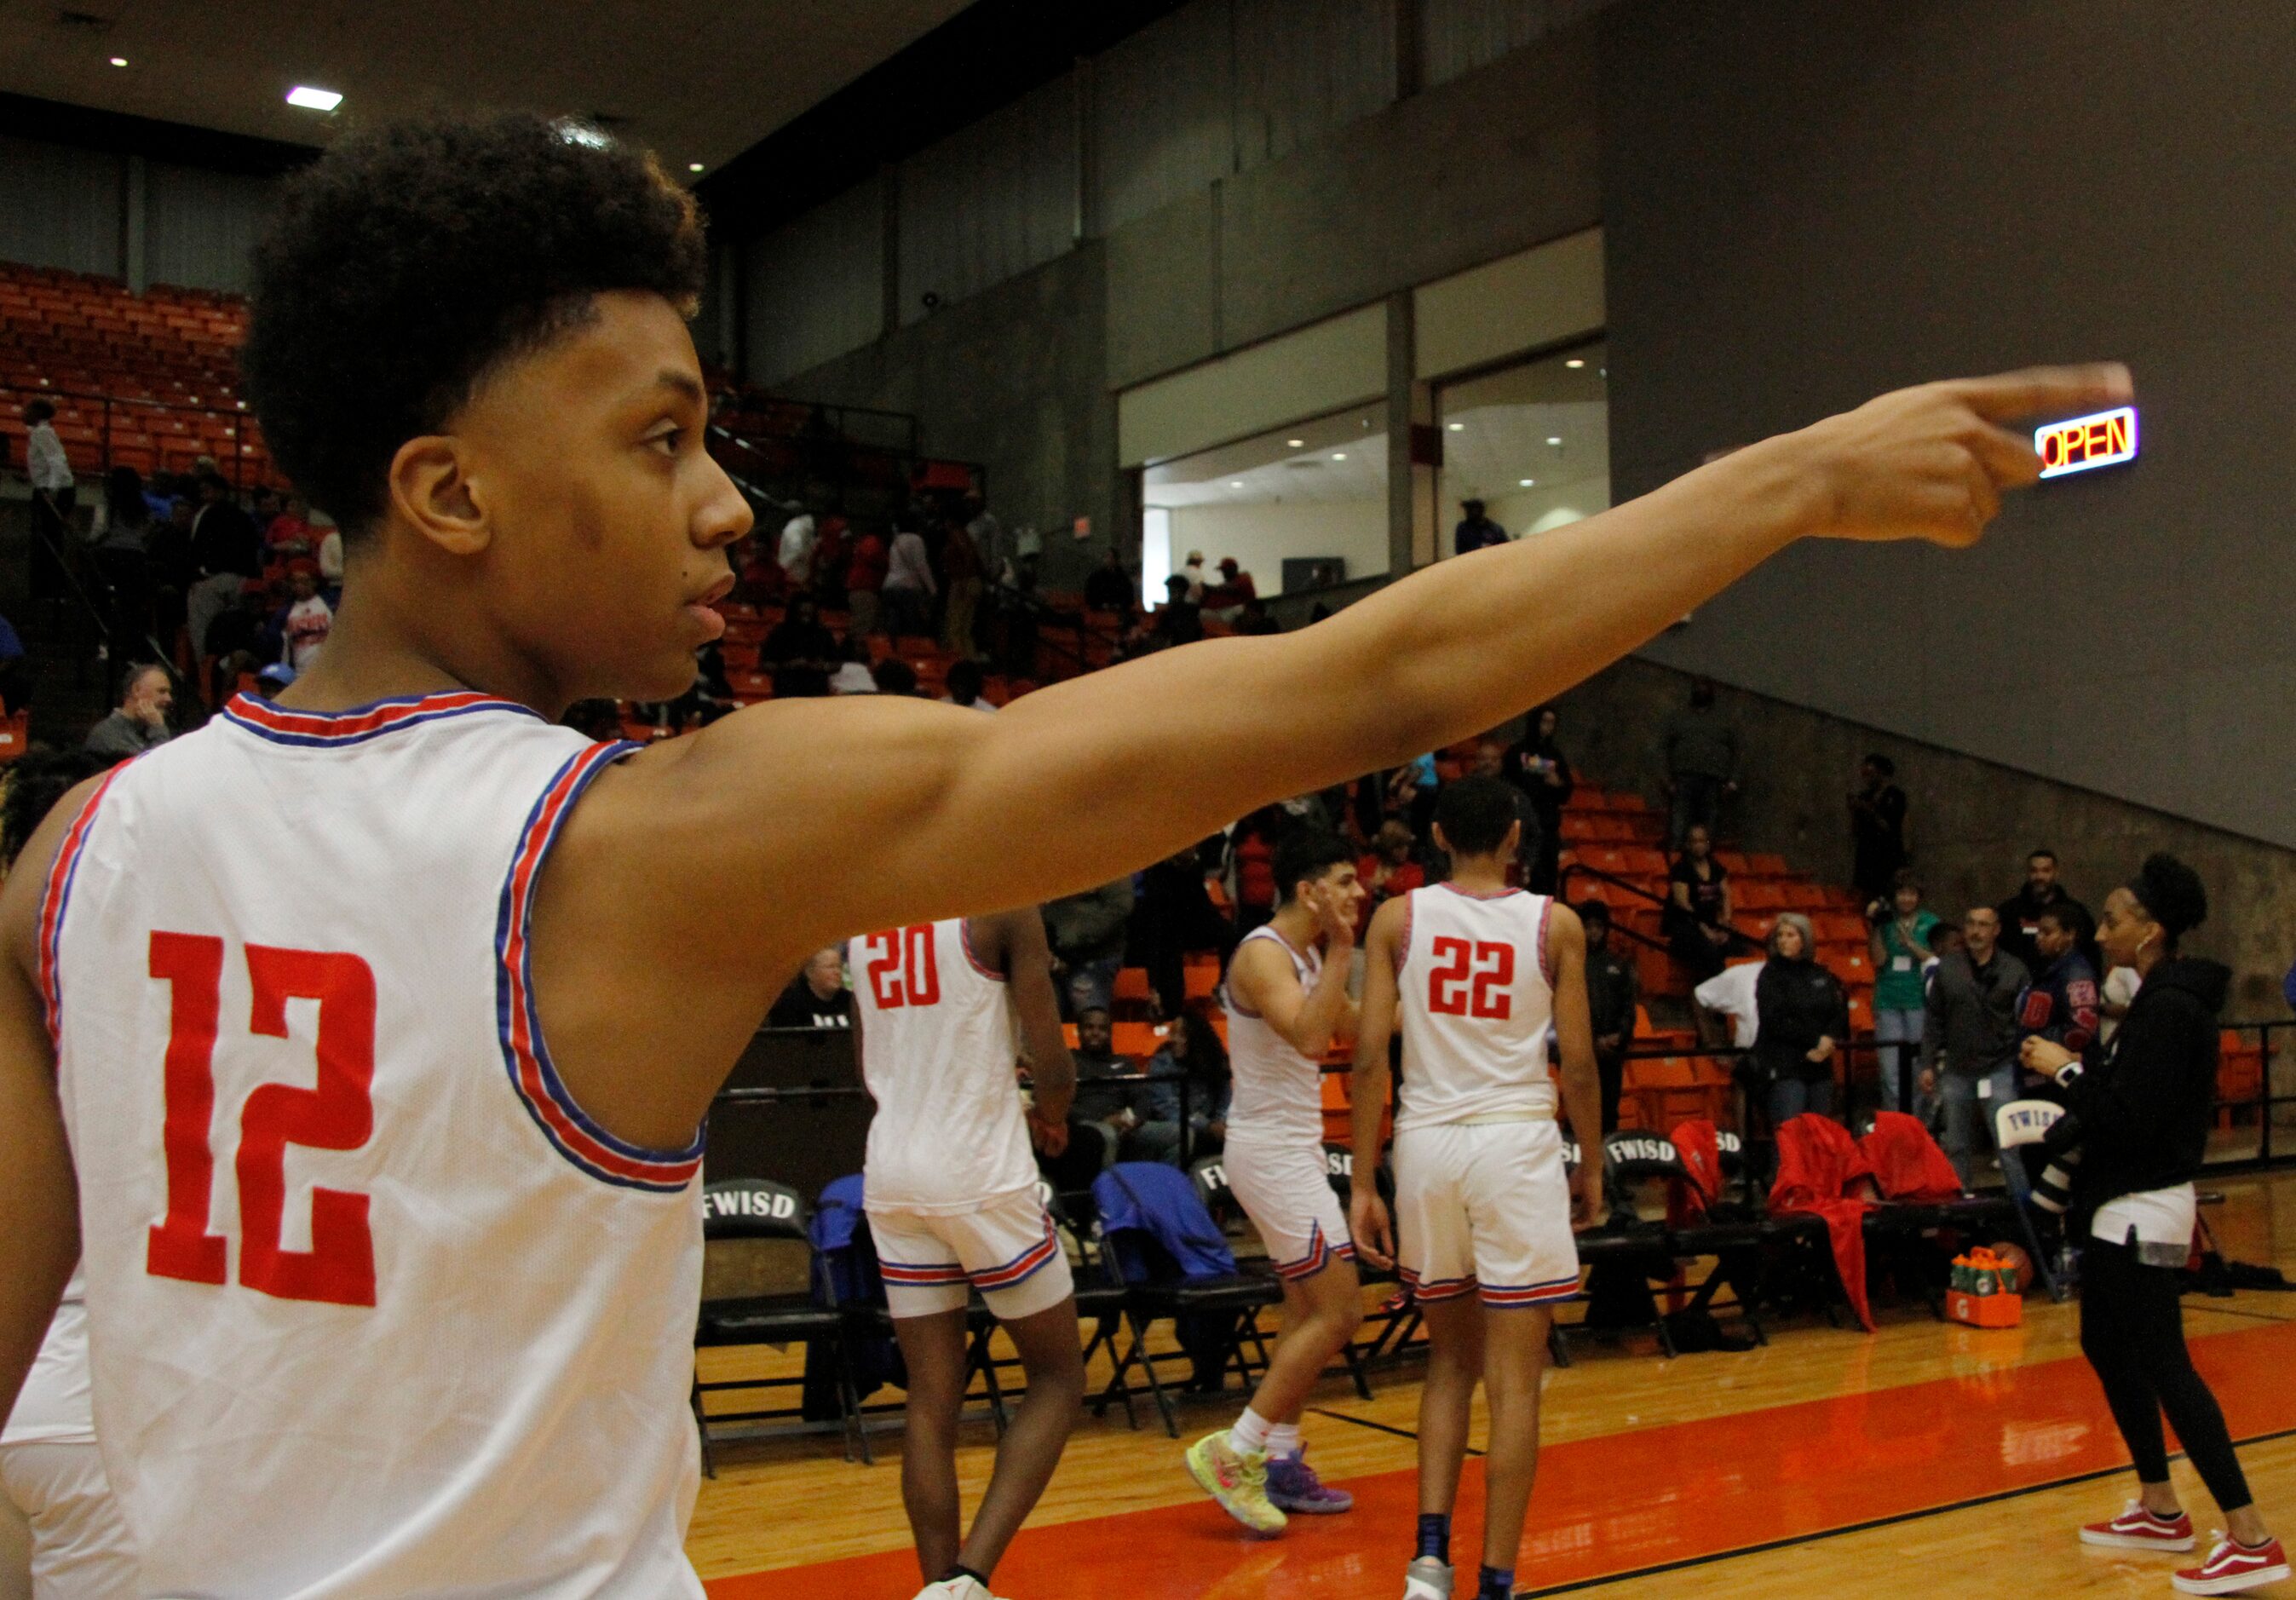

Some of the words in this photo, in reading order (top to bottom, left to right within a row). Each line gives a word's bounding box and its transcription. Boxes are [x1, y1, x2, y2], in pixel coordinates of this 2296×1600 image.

[2042, 415, 2129, 469] OPEN
[866, 923, 940, 1009] 20
[1429, 935, 1515, 1021] 22
[147, 929, 377, 1307] 12
[1606, 1138, 1676, 1164] FWISD
[702, 1190, 795, 1219] FWISD
